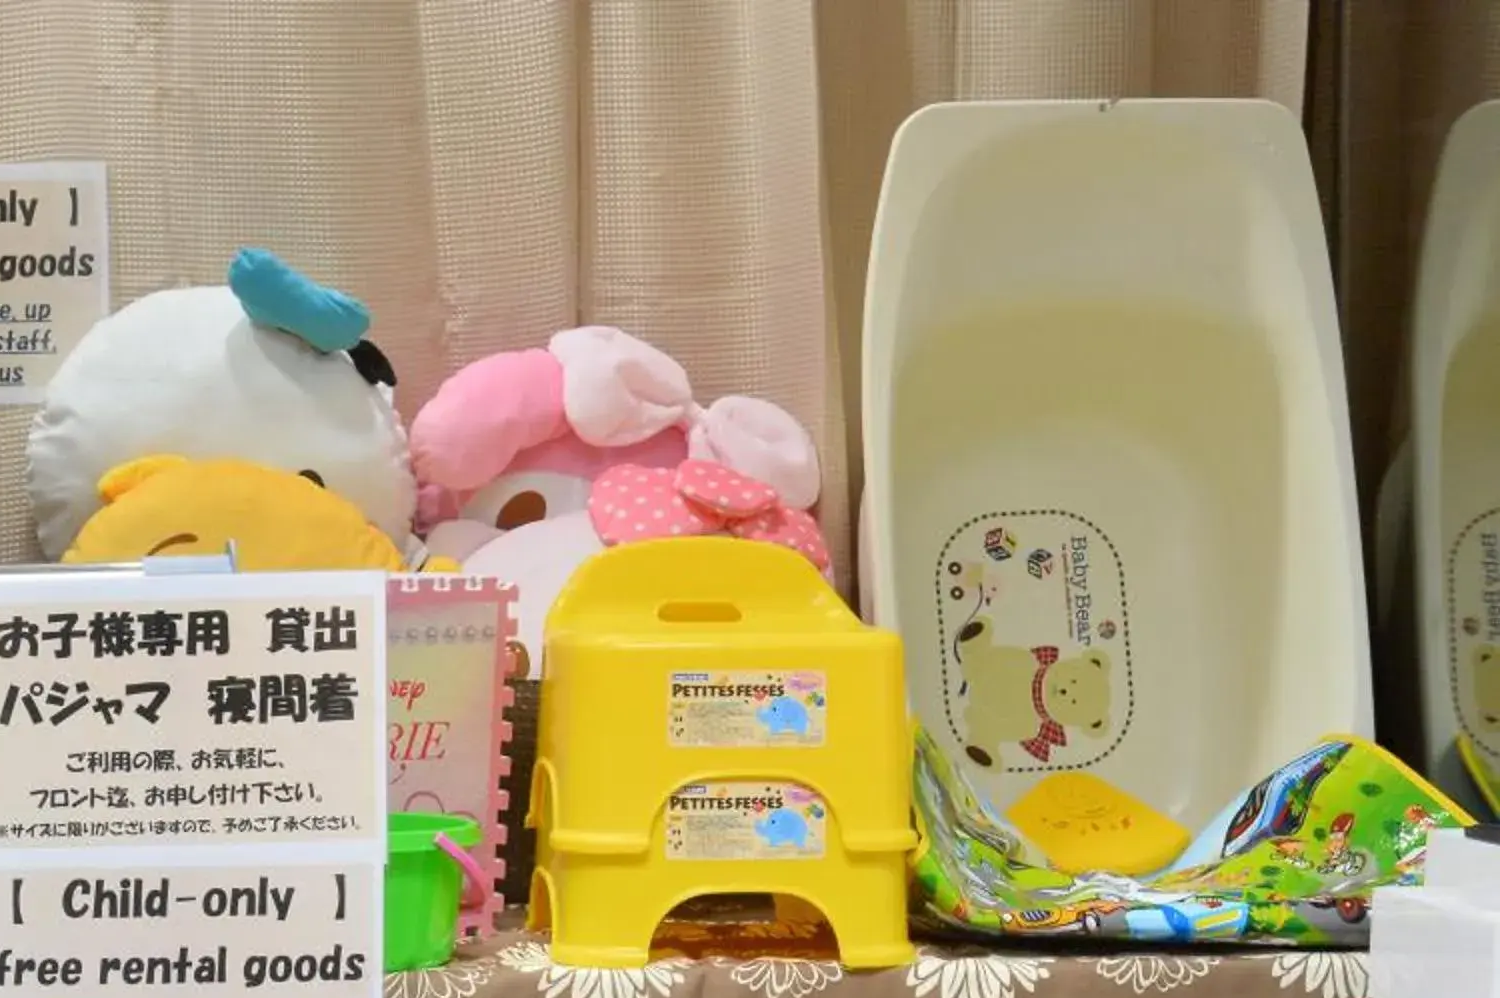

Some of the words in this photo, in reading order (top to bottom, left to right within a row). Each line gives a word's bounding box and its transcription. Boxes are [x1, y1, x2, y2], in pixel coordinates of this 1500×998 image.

[25, 303, 51, 322] up
[0, 365, 24, 383] us
[265, 606, 357, 653] 貸出
[0, 682, 171, 726] パジャマ
[208, 673, 358, 724] 寝間着
[62, 876, 295, 921] Child-only
[100, 947, 227, 985] rental
[243, 945, 365, 987] goods
